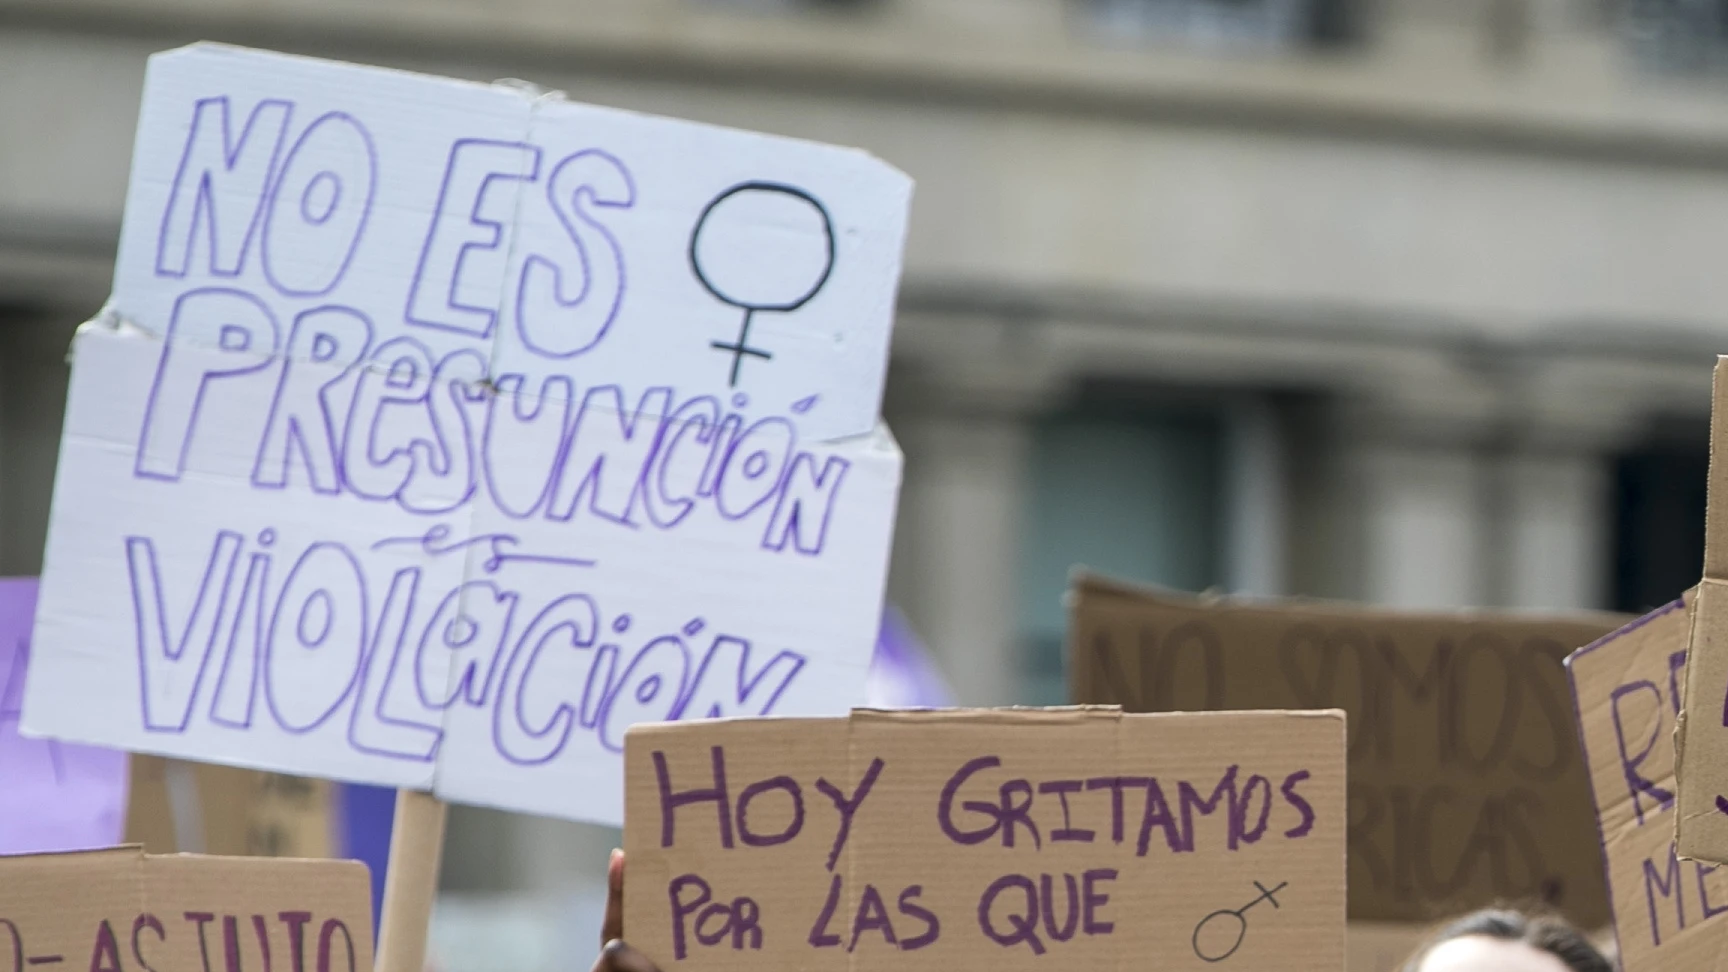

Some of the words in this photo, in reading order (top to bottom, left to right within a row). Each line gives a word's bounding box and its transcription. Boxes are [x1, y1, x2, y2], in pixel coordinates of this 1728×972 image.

[154, 95, 378, 298] NO
[404, 138, 637, 358] ES
[652, 746, 885, 871] HOY
[937, 756, 1315, 857] GRITAMOS
[807, 874, 940, 953] LAS
[977, 868, 1119, 955] QUE
